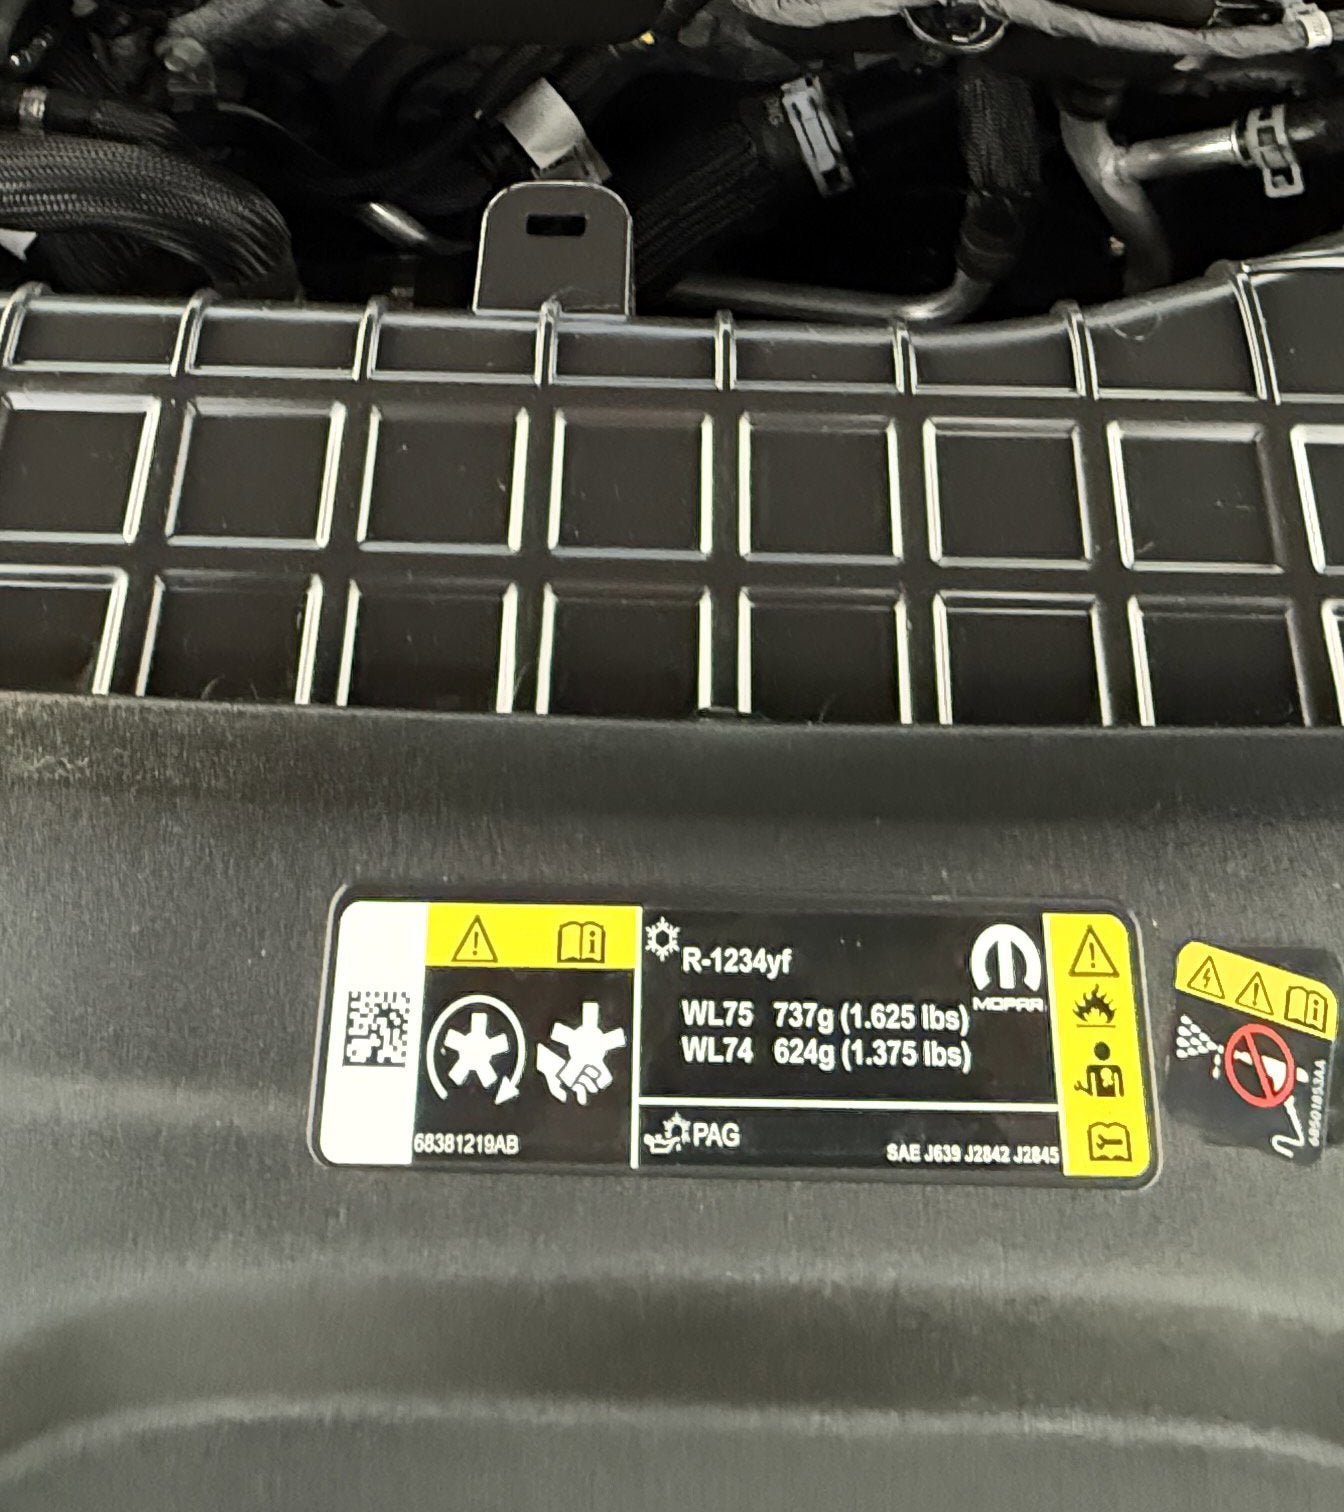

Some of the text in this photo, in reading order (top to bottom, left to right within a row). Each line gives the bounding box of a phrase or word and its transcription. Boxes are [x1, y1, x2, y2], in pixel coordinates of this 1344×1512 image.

[682, 946, 793, 981] R-1234yf
[972, 996, 1045, 1013] MOPAR
[681, 999, 970, 1038] WL75 737g (1.625 lbs)
[681, 1035, 972, 1075] WL74 624g (1.375 lbs)
[413, 1133, 521, 1156] 68381219AB
[692, 1122, 741, 1148] PAG
[885, 1143, 1060, 1165] SAE J639 J2842 J2845
